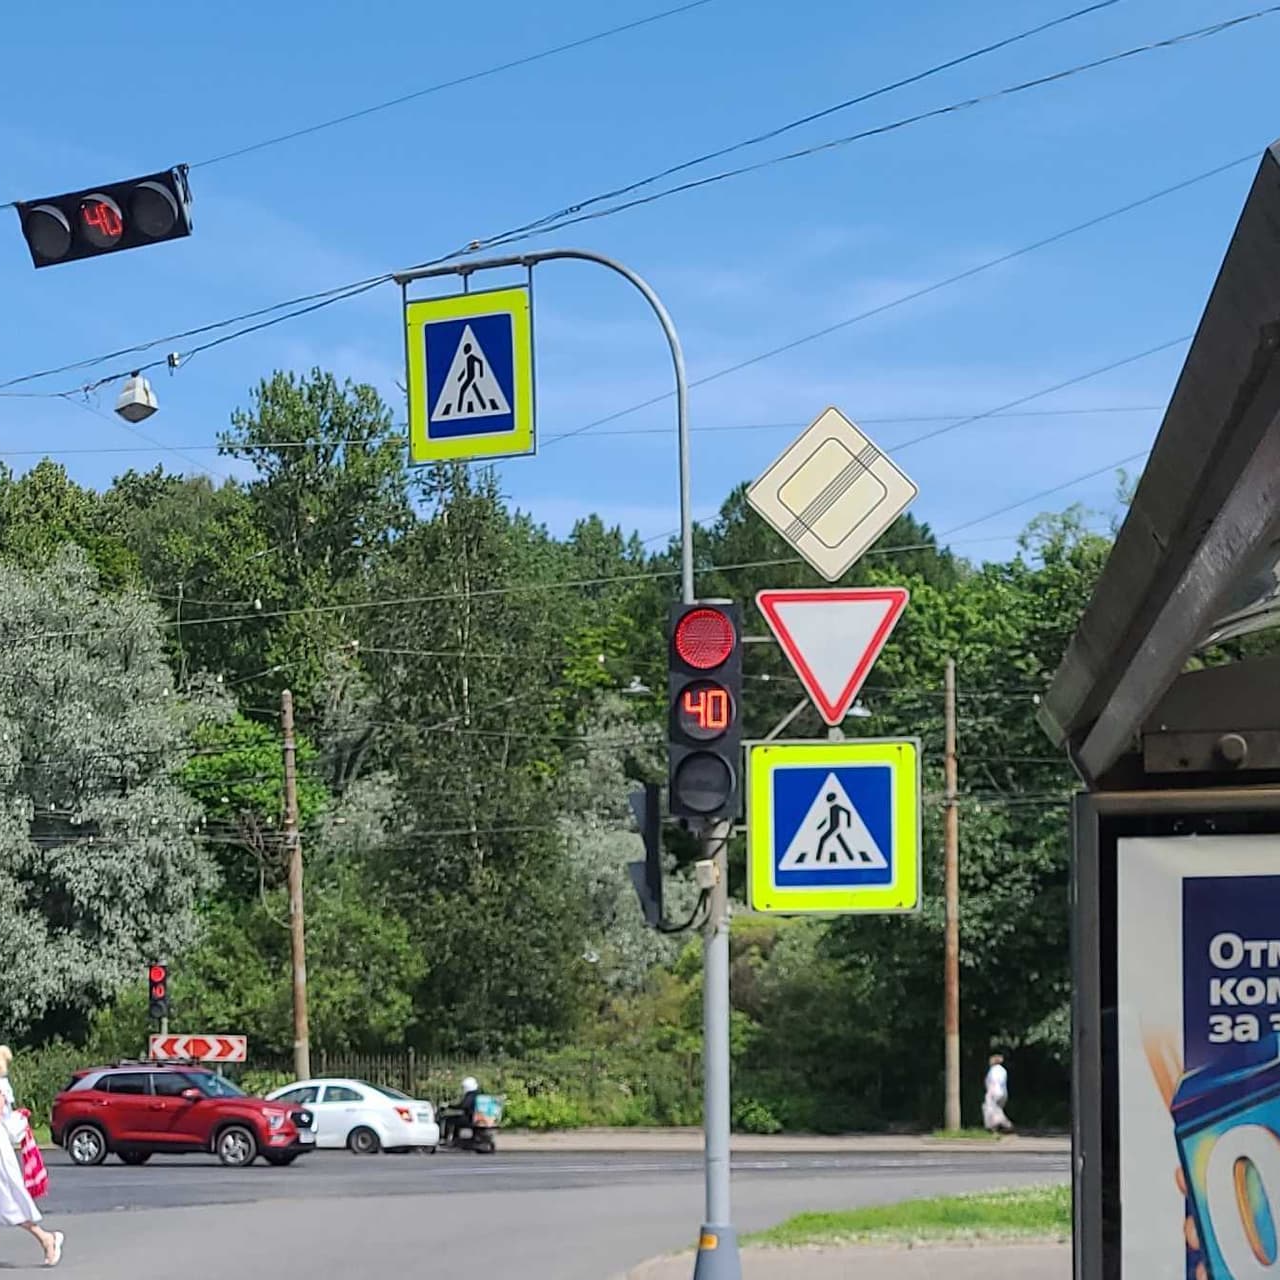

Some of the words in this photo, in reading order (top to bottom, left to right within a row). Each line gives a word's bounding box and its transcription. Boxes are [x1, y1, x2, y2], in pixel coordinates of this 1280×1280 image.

[84, 203, 122, 236] 40
[684, 689, 728, 729] 40
[1209, 1012, 1260, 1043] за
